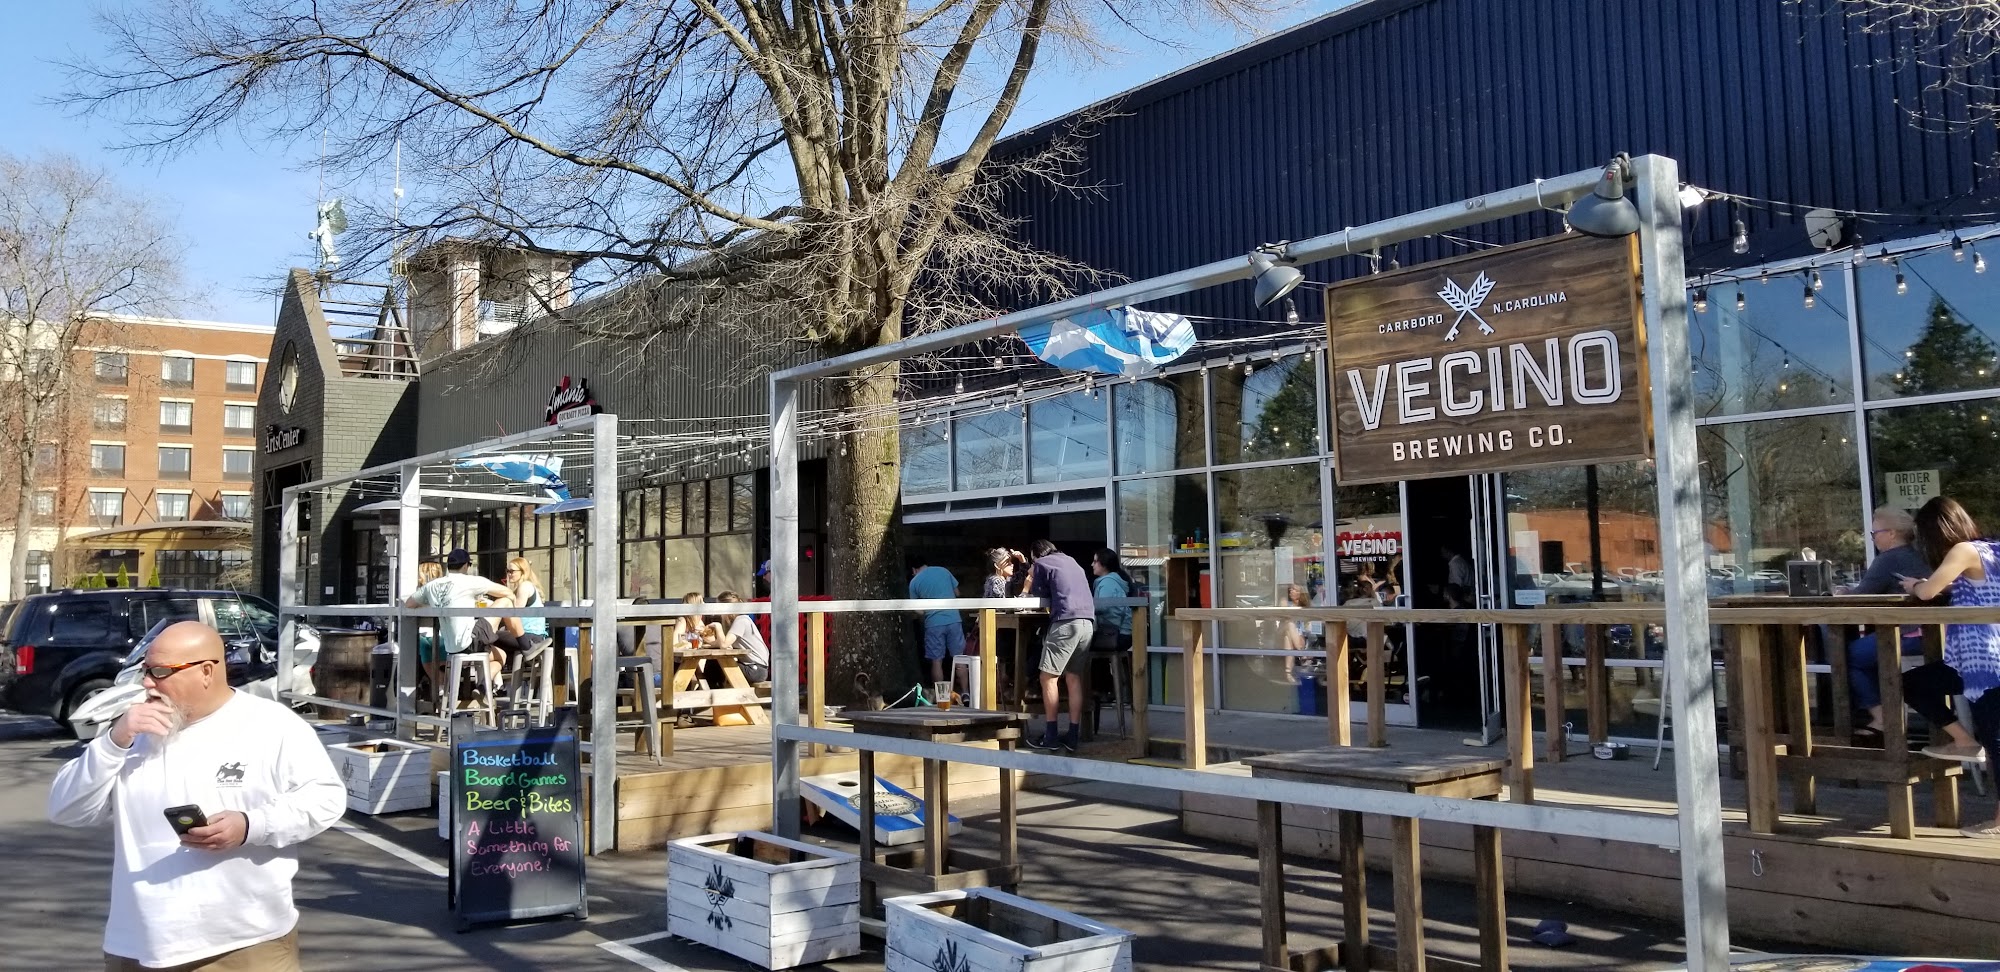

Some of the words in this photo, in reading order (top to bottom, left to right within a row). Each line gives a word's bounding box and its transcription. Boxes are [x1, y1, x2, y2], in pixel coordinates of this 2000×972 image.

[1378, 313, 1443, 335] CARRBORO
[1346, 329, 1622, 431] VECINO
[577, 407, 590, 418] PIZZA
[1392, 429, 1514, 462] BREWING
[1528, 424, 1573, 449] CO.
[1894, 471, 1931, 485] ORDER
[1899, 484, 1927, 496] HERE
[1342, 538, 1397, 556] VECINO
[463, 749, 558, 766] Basketball
[465, 768, 516, 787] Board
[518, 773, 567, 788] Games
[466, 791, 518, 811] Beer
[527, 791, 572, 814] Bites
[467, 820, 480, 836] A
[489, 820, 536, 835] Little
[467, 839, 548, 856] Something
[471, 857, 552, 879] Everyone!
